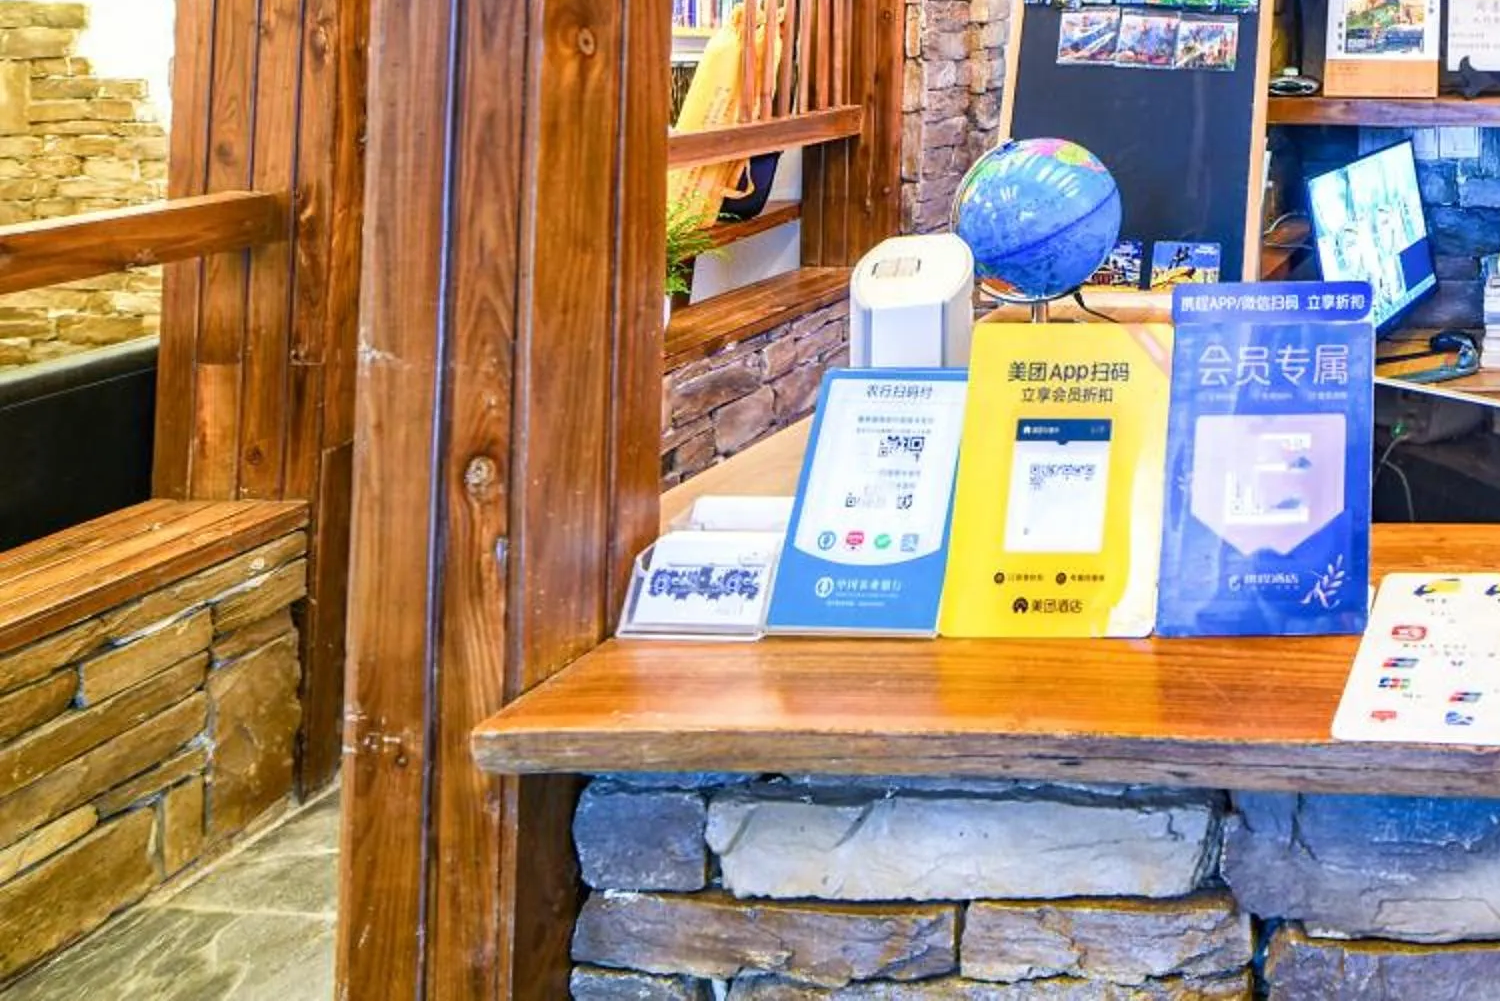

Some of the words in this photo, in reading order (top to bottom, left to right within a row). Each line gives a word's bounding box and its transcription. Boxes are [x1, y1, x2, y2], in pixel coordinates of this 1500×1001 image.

[1306, 294, 1365, 310] 立享折扣
[1008, 360, 1130, 383] 美团App扫码
[1199, 344, 1349, 386] 会员专属
[1022, 386, 1113, 403] 立享会员折扣
